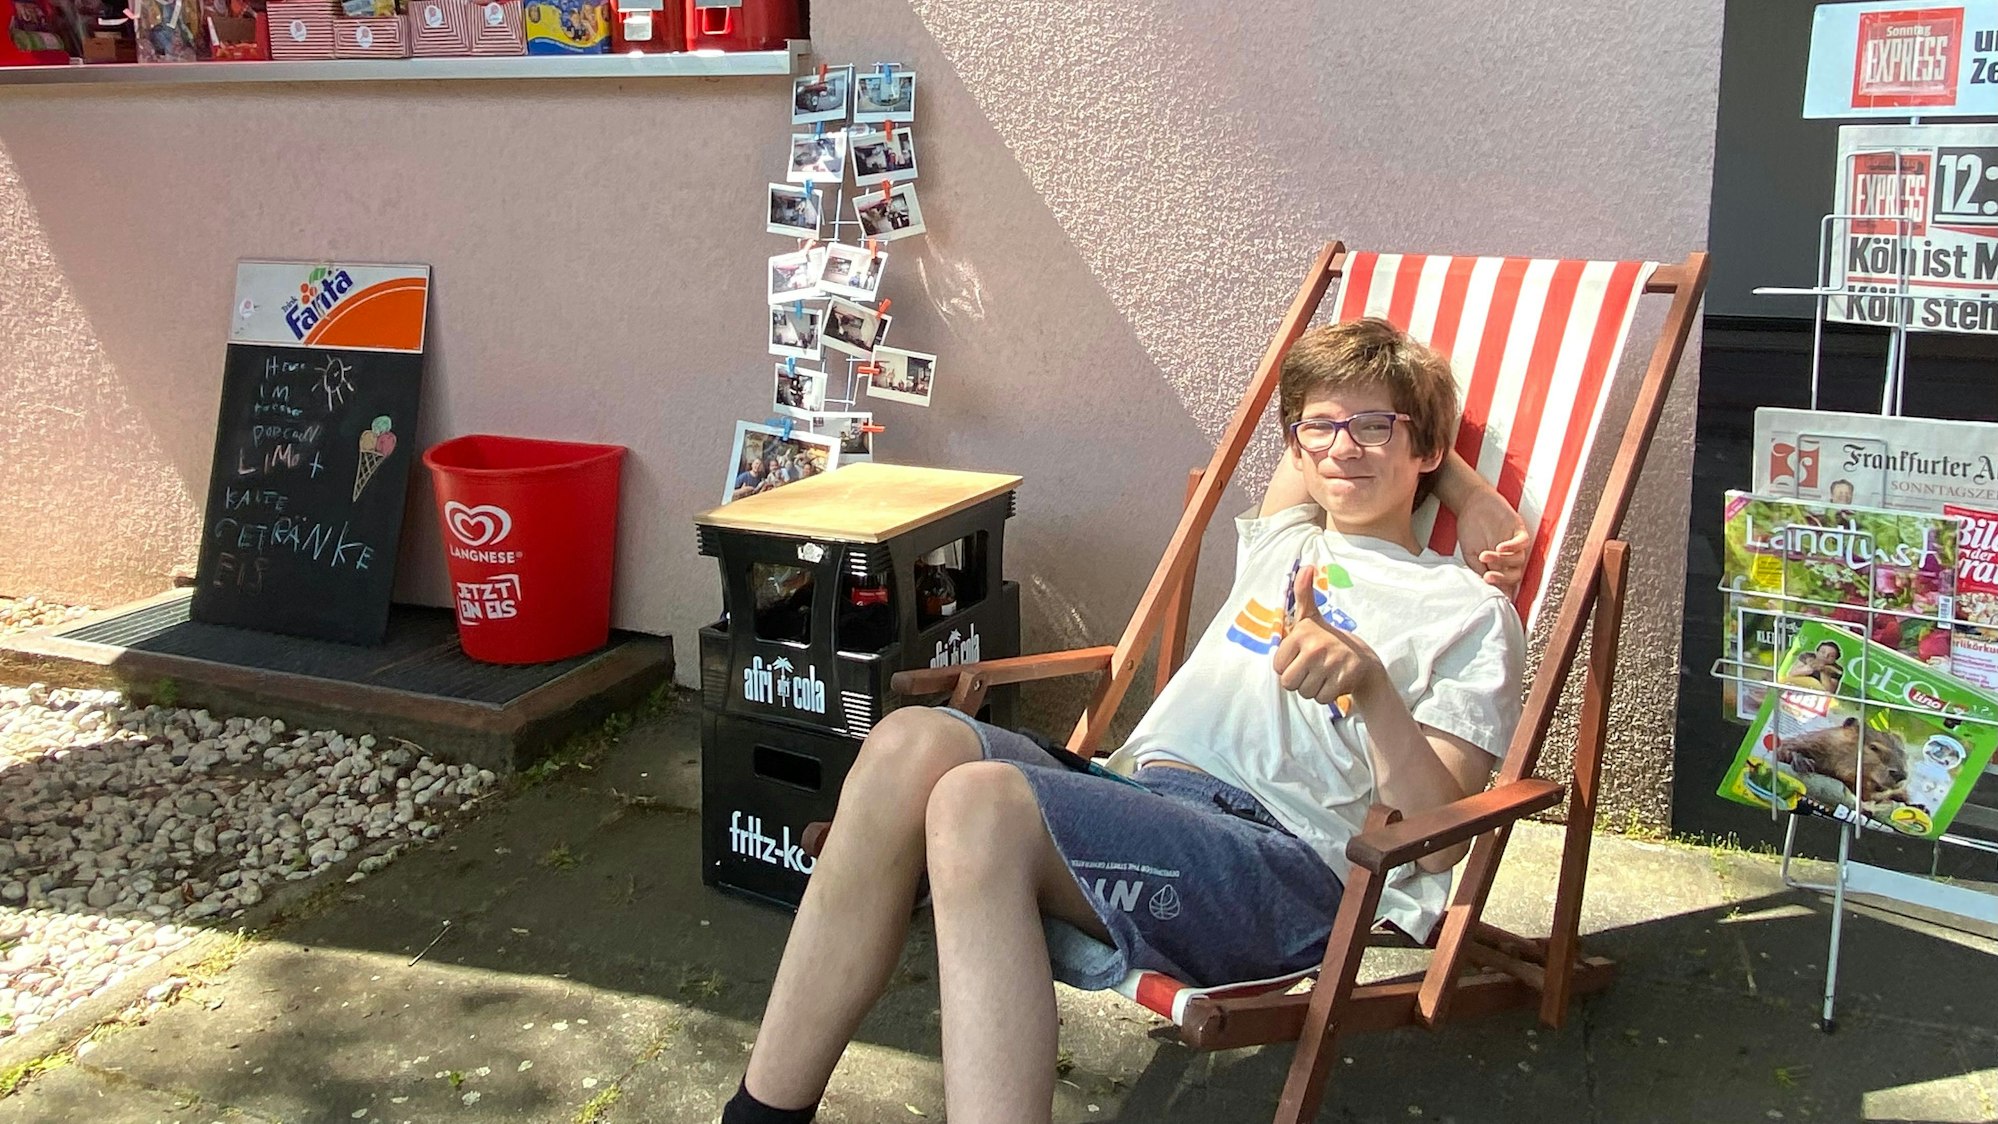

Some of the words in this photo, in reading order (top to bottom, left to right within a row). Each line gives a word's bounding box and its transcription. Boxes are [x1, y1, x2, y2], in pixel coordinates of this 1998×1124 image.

[1886, 25, 1932, 38] Sonntag
[1974, 30, 1998, 52] u
[1866, 36, 1948, 83] EXPRESS
[1849, 237, 1916, 276] Köln
[1922, 240, 1967, 278] ist
[285, 269, 354, 341] Fanta
[1843, 444, 1972, 478] Frankfurter
[449, 544, 516, 564] LANGNESE
[743, 655, 774, 705] afri
[792, 664, 826, 715] cola
[1847, 656, 1939, 709] GEO
